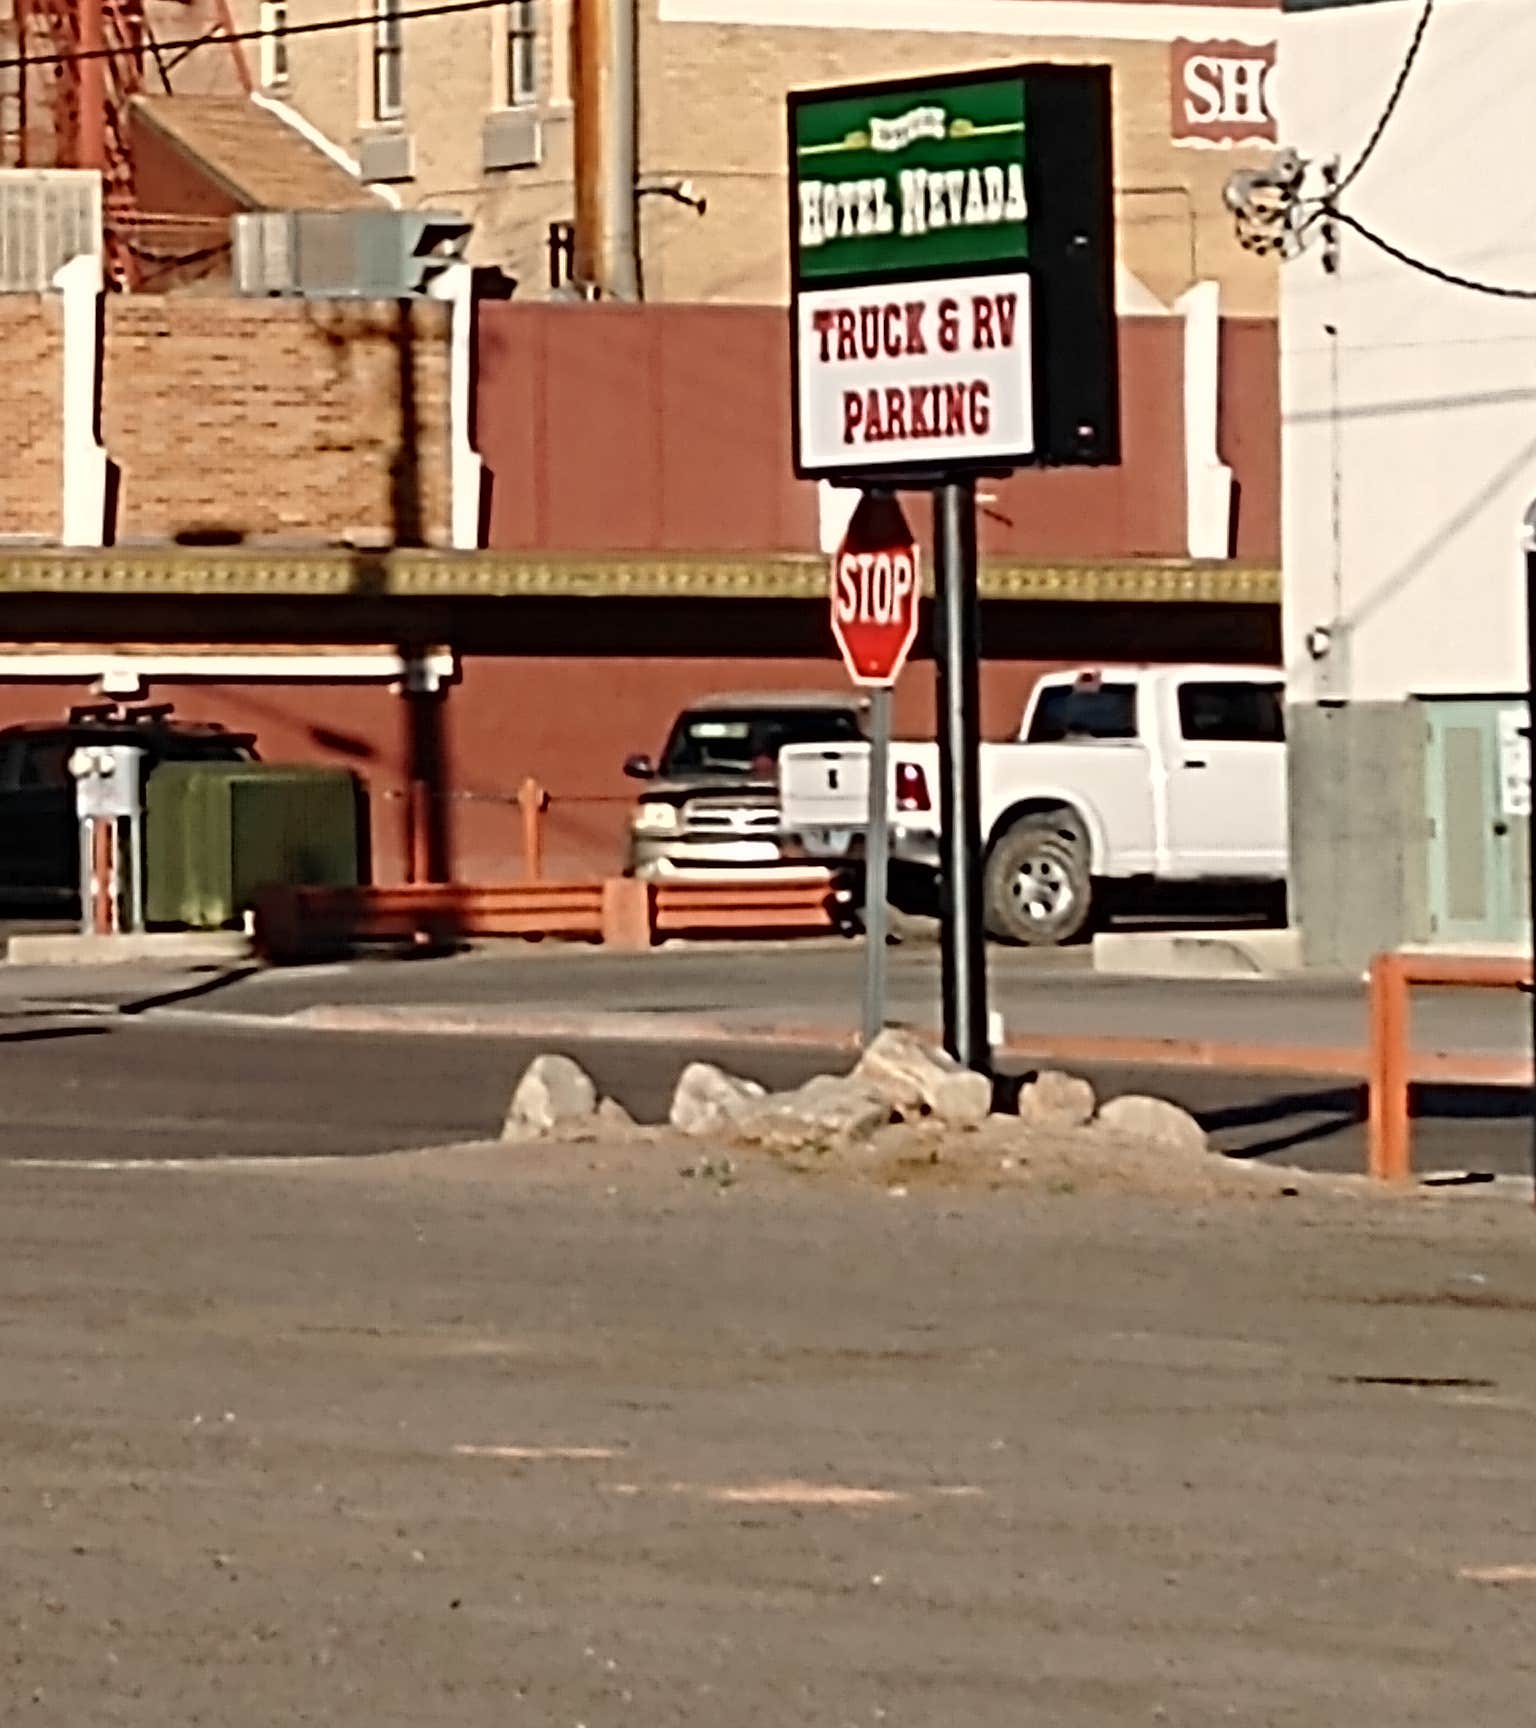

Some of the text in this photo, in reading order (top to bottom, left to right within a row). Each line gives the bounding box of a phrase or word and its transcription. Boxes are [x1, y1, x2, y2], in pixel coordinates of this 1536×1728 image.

[1183, 55, 1277, 124] SH
[799, 164, 1028, 246] HOTEL NEVADA
[813, 293, 1018, 362] TRUCK & RV
[843, 379, 990, 444] PARKING
[839, 553, 912, 624] STOP
